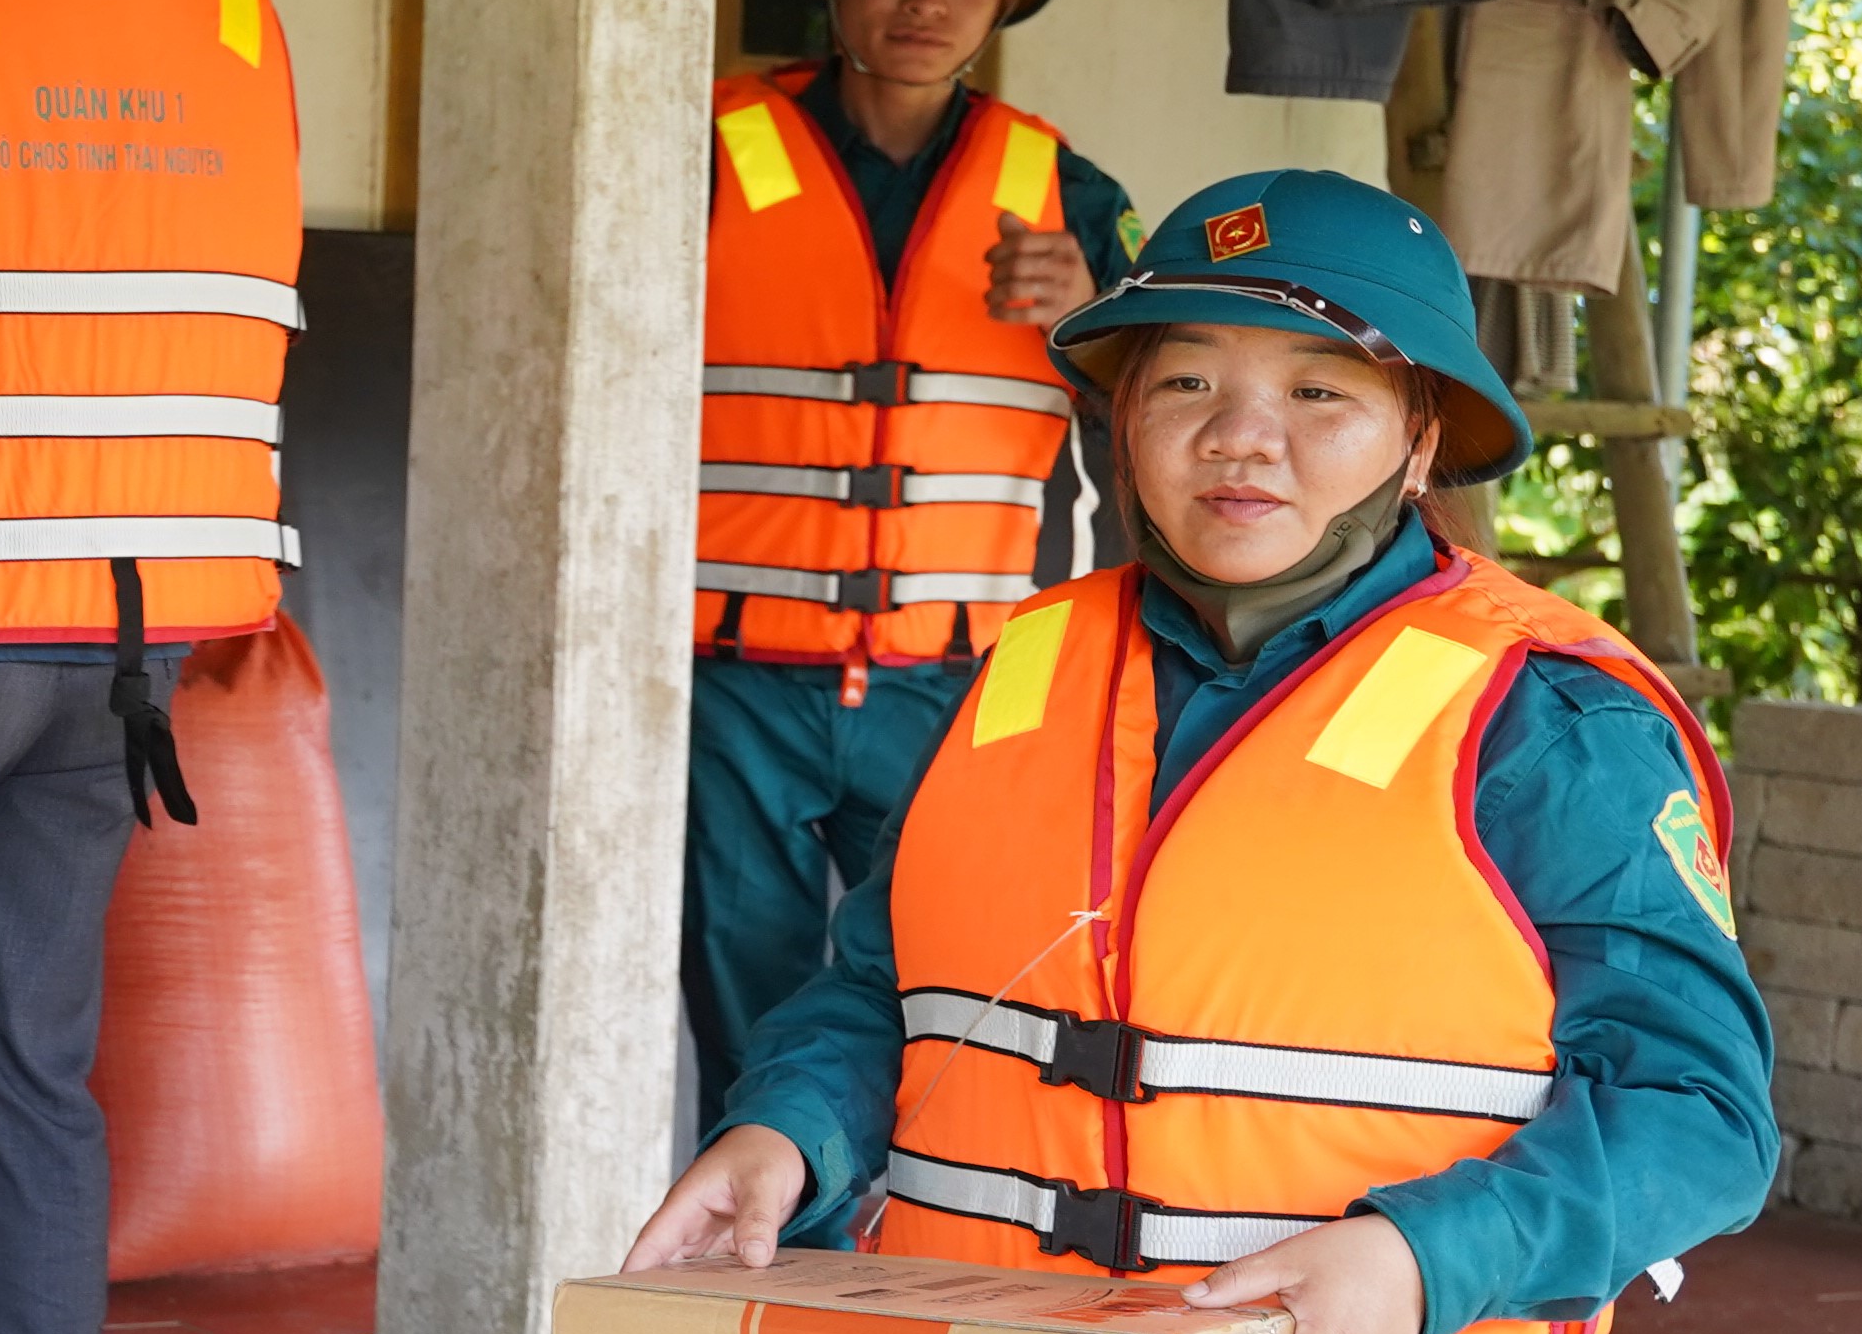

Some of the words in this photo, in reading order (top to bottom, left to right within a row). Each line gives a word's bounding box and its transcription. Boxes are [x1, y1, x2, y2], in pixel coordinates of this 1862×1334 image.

[35, 80, 108, 122] QUÂN
[118, 88, 166, 123] KHU
[175, 92, 185, 124] 1
[19, 140, 69, 171] CHQS
